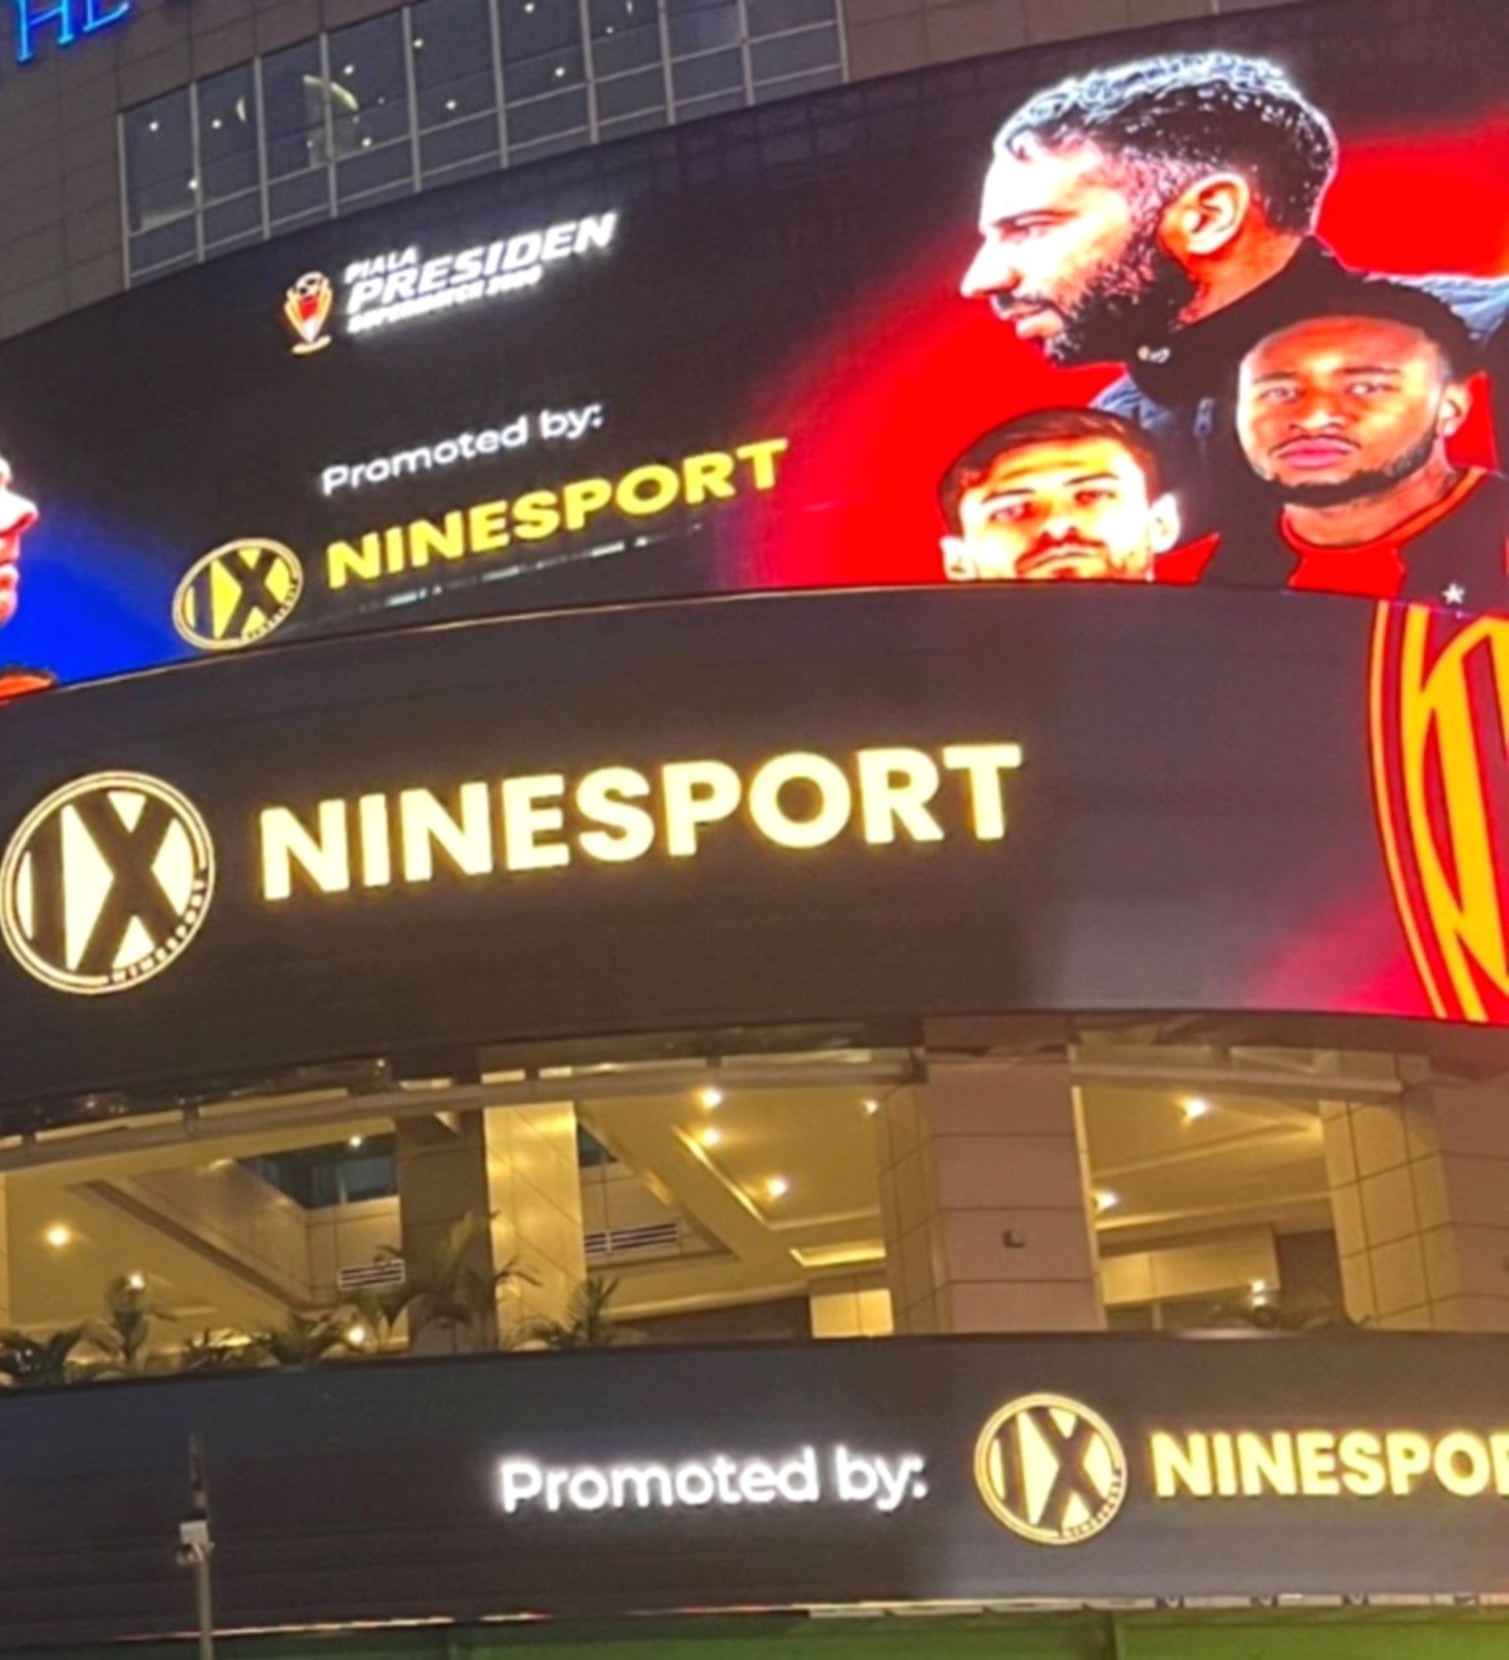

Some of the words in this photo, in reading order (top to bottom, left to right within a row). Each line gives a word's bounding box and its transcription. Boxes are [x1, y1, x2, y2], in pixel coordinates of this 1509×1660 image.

[344, 244, 420, 284] PIALA
[345, 209, 618, 315] PRESIDEN
[322, 414, 529, 496] Promoted
[539, 403, 603, 440] by:
[326, 437, 788, 589] NINESPORT
[259, 743, 1023, 902] NINESPORT
[497, 1445, 820, 1513] Promoted
[832, 1444, 928, 1511] by:
